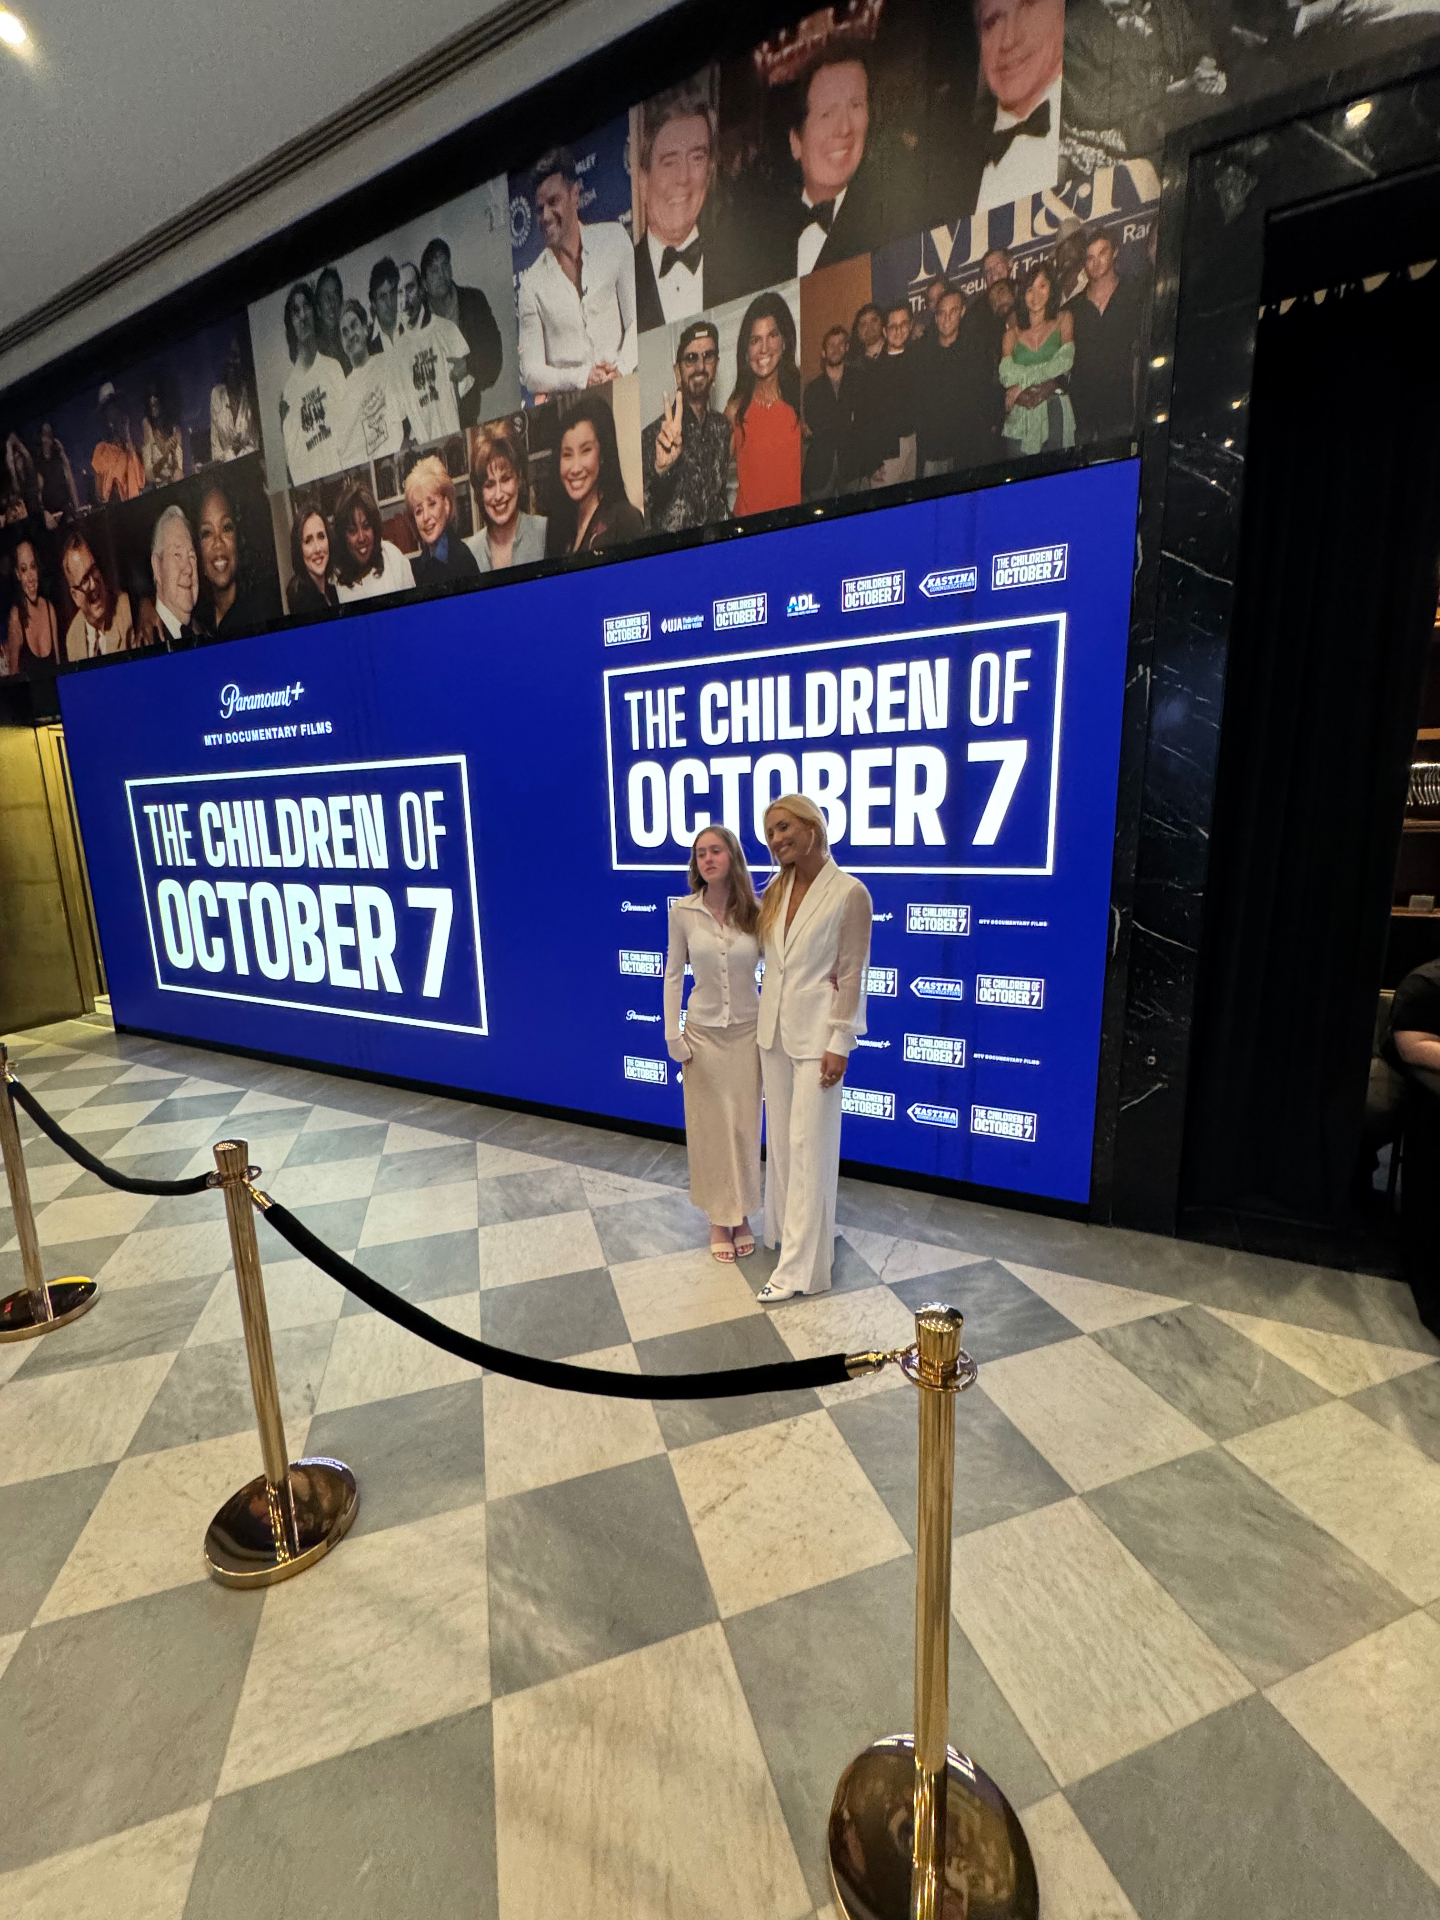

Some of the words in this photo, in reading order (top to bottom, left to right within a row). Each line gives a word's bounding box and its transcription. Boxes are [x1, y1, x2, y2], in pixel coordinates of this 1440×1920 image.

[997, 557, 1009, 569] THE
[1010, 550, 1052, 567] CHILDREN
[1054, 549, 1063, 560] OF
[927, 572, 974, 588] KASTINA
[996, 562, 1052, 586] OCTOBER
[1053, 561, 1063, 578] 7
[845, 582, 856, 593] THE
[856, 576, 892, 592] CHILDREN
[893, 575, 901, 586] OF
[716, 603, 725, 613] THE
[726, 598, 756, 612] CHILDREN
[757, 597, 764, 607] OF
[845, 587, 892, 608] OCTOBER
[893, 585, 901, 602] 7
[606, 621, 615, 630] THE
[615, 617, 641, 629] CHILDREN
[642, 616, 647, 625] OF
[667, 617, 683, 632] UJA
[716, 609, 756, 627] OCTOBER
[757, 607, 764, 621] 7
[606, 626, 641, 643] OCTOBER
[642, 625, 648, 638] 7
[220, 681, 305, 719] Paramount+
[623, 685, 687, 751] THE
[699, 657, 951, 747] CHILDREN
[968, 648, 1032, 728] OF
[204, 733, 223, 746] MTV
[225, 725, 298, 744] DOCUMENTARY
[300, 720, 333, 736] FILMS
[626, 745, 947, 849] OCTOBER
[966, 739, 1028, 847] 7
[143, 804, 197, 867] THE
[198, 793, 389, 869] CHILDREN
[399, 790, 447, 870] OF
[910, 907, 921, 917] THE
[922, 907, 957, 918] CHILDREN
[958, 908, 967, 918] OF
[910, 917, 957, 932] OCTOBER
[958, 918, 967, 932] 7
[156, 878, 404, 995] OCTOBER
[405, 887, 454, 999] 7
[621, 953, 630, 961] THE
[630, 953, 654, 962] CHILDREN
[655, 955, 660, 963] OF
[621, 961, 654, 974] OCTOBER
[655, 963, 661, 974] 7
[887, 971, 895, 981] OF
[886, 981, 895, 994] 7
[917, 981, 960, 992] KASTINA
[980, 978, 992, 988] THE
[993, 978, 1030, 991] CHILDREN
[1031, 981, 1040, 992] OF
[979, 987, 1030, 1005] OCTOBER
[1031, 991, 1040, 1006] 7
[907, 1037, 919, 1047] THE
[919, 1038, 953, 1051] CHILDREN
[954, 1041, 962, 1051] OF
[907, 1046, 953, 1064] OCTOBER
[954, 1051, 962, 1064] 7
[627, 1058, 635, 1067] THE
[659, 1063, 665, 1071] OF
[627, 1066, 658, 1081] OCTOBER
[659, 1070, 665, 1082] 7
[842, 1089, 852, 1099] THE
[852, 1091, 883, 1104] CHILDREN
[884, 1095, 892, 1105] OF
[842, 1098, 883, 1116] OCTOBER
[884, 1104, 892, 1117] 7
[914, 1107, 955, 1120] KASTINA
[975, 1108, 986, 1119] THE
[987, 1110, 1023, 1125] CHILDREN
[1024, 1115, 1033, 1126] OF
[974, 1117, 1023, 1137] OCTOBER
[1024, 1125, 1033, 1139] 7
